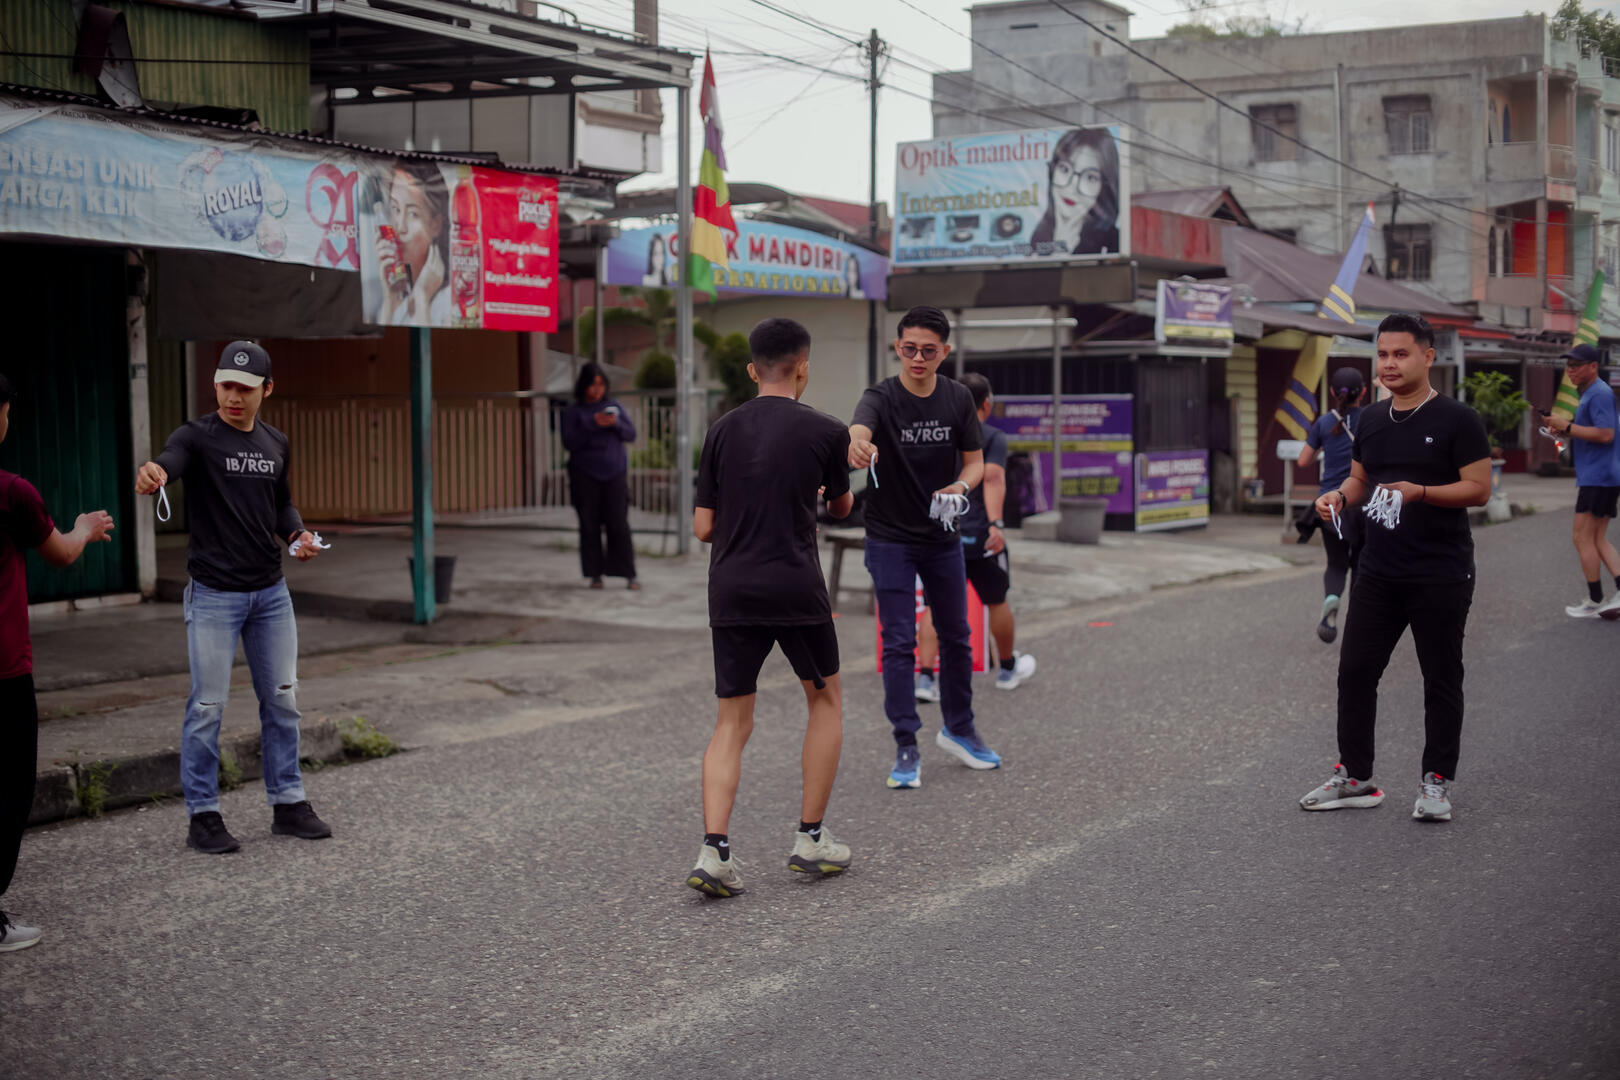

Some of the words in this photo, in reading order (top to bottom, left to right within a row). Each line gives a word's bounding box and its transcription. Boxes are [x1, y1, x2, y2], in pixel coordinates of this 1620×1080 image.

[900, 141, 959, 176] Optik
[965, 132, 1049, 165] mandiri
[204, 179, 262, 218] ROYAL
[901, 183, 1039, 215] International
[749, 233, 842, 271] MANDIRI
[901, 427, 951, 443] IB/RGT
[226, 458, 275, 474] IB/RGT
